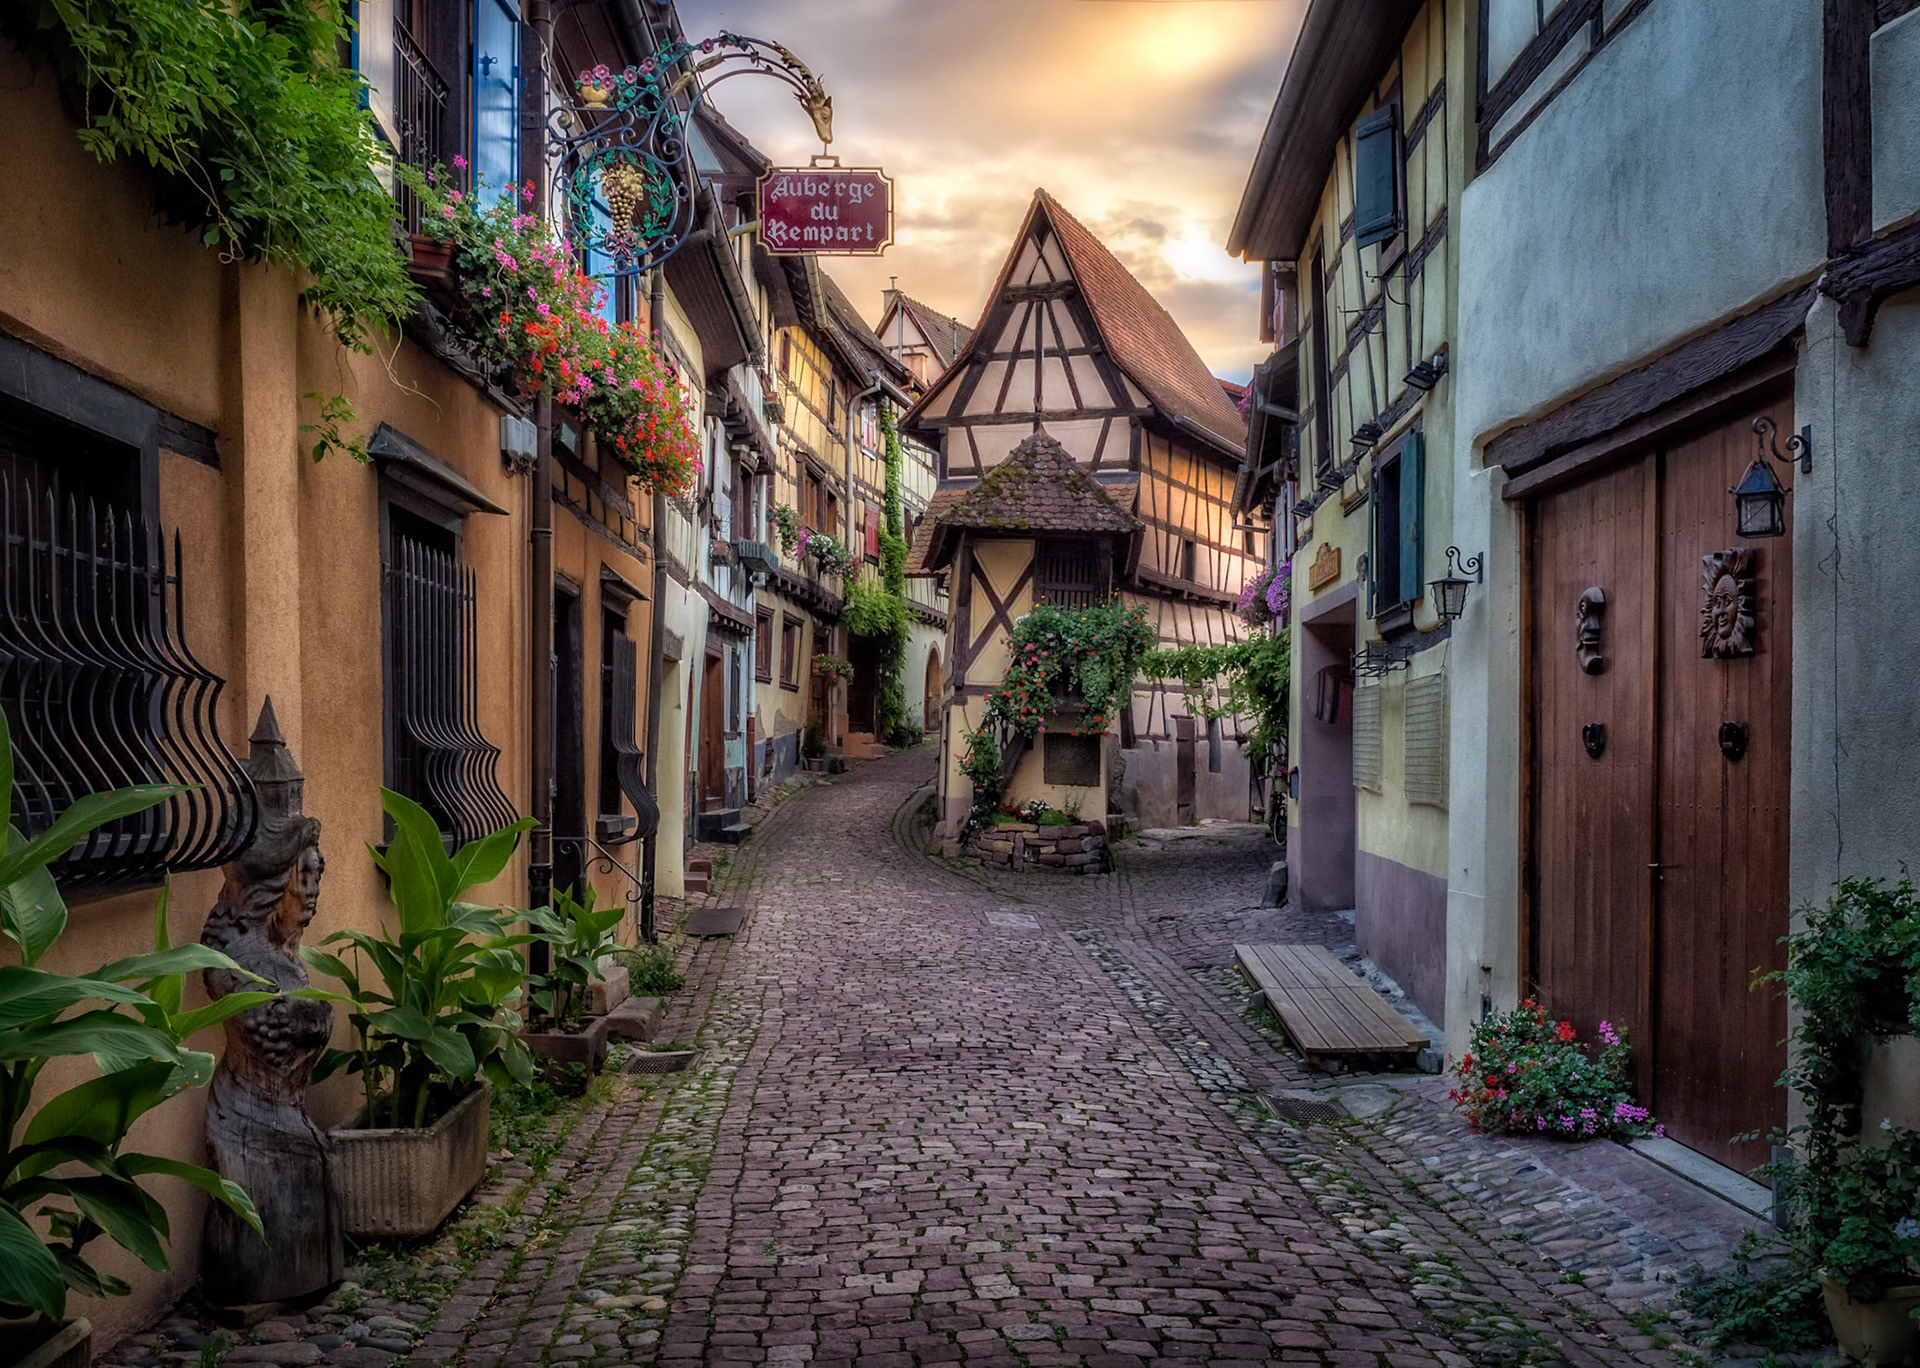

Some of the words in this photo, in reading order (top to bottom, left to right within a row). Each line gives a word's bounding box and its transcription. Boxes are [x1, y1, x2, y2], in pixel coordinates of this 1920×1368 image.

[771, 176, 875, 204] Auberge
[810, 201, 839, 221] du
[767, 218, 875, 246] Rempart
